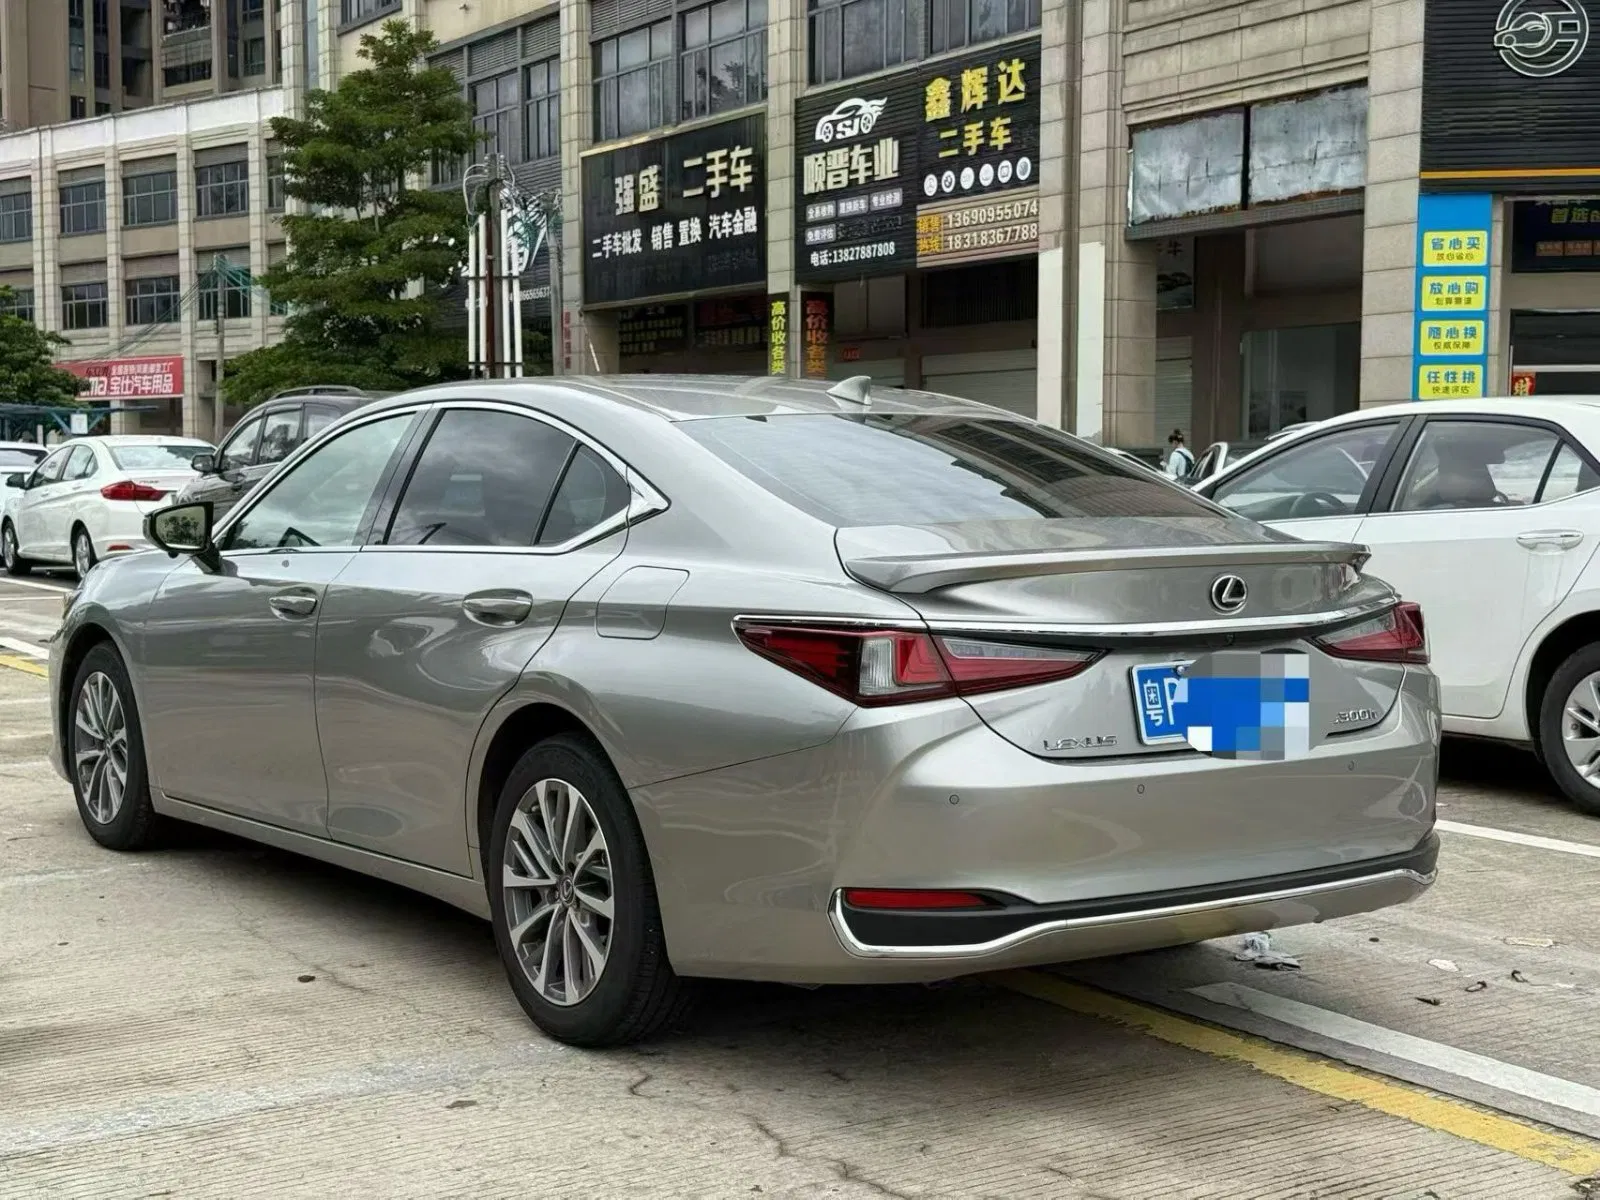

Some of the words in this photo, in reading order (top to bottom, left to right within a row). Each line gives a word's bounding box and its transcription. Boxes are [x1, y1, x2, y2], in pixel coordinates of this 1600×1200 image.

[924, 58, 1026, 122] 鑫辉达
[938, 117, 1012, 158] 二手车
[803, 137, 899, 195] 顺晋车业
[614, 165, 661, 216] 强盛
[682, 145, 753, 198] 二手车
[947, 200, 1037, 228] 13690955074
[592, 228, 642, 259] 二手车批发
[651, 222, 674, 250] 销售
[678, 217, 702, 246] 置换
[708, 206, 758, 240] 汽车金融
[947, 222, 1037, 250] 18318367788
[1431, 237, 1481, 251] 省心买
[1429, 281, 1479, 295] 放心购
[771, 301, 786, 375] 高价收各类
[1428, 326, 1477, 339] 随心换
[1427, 371, 1475, 384] 任性挑
[1043, 733, 1118, 751] LEXUS
